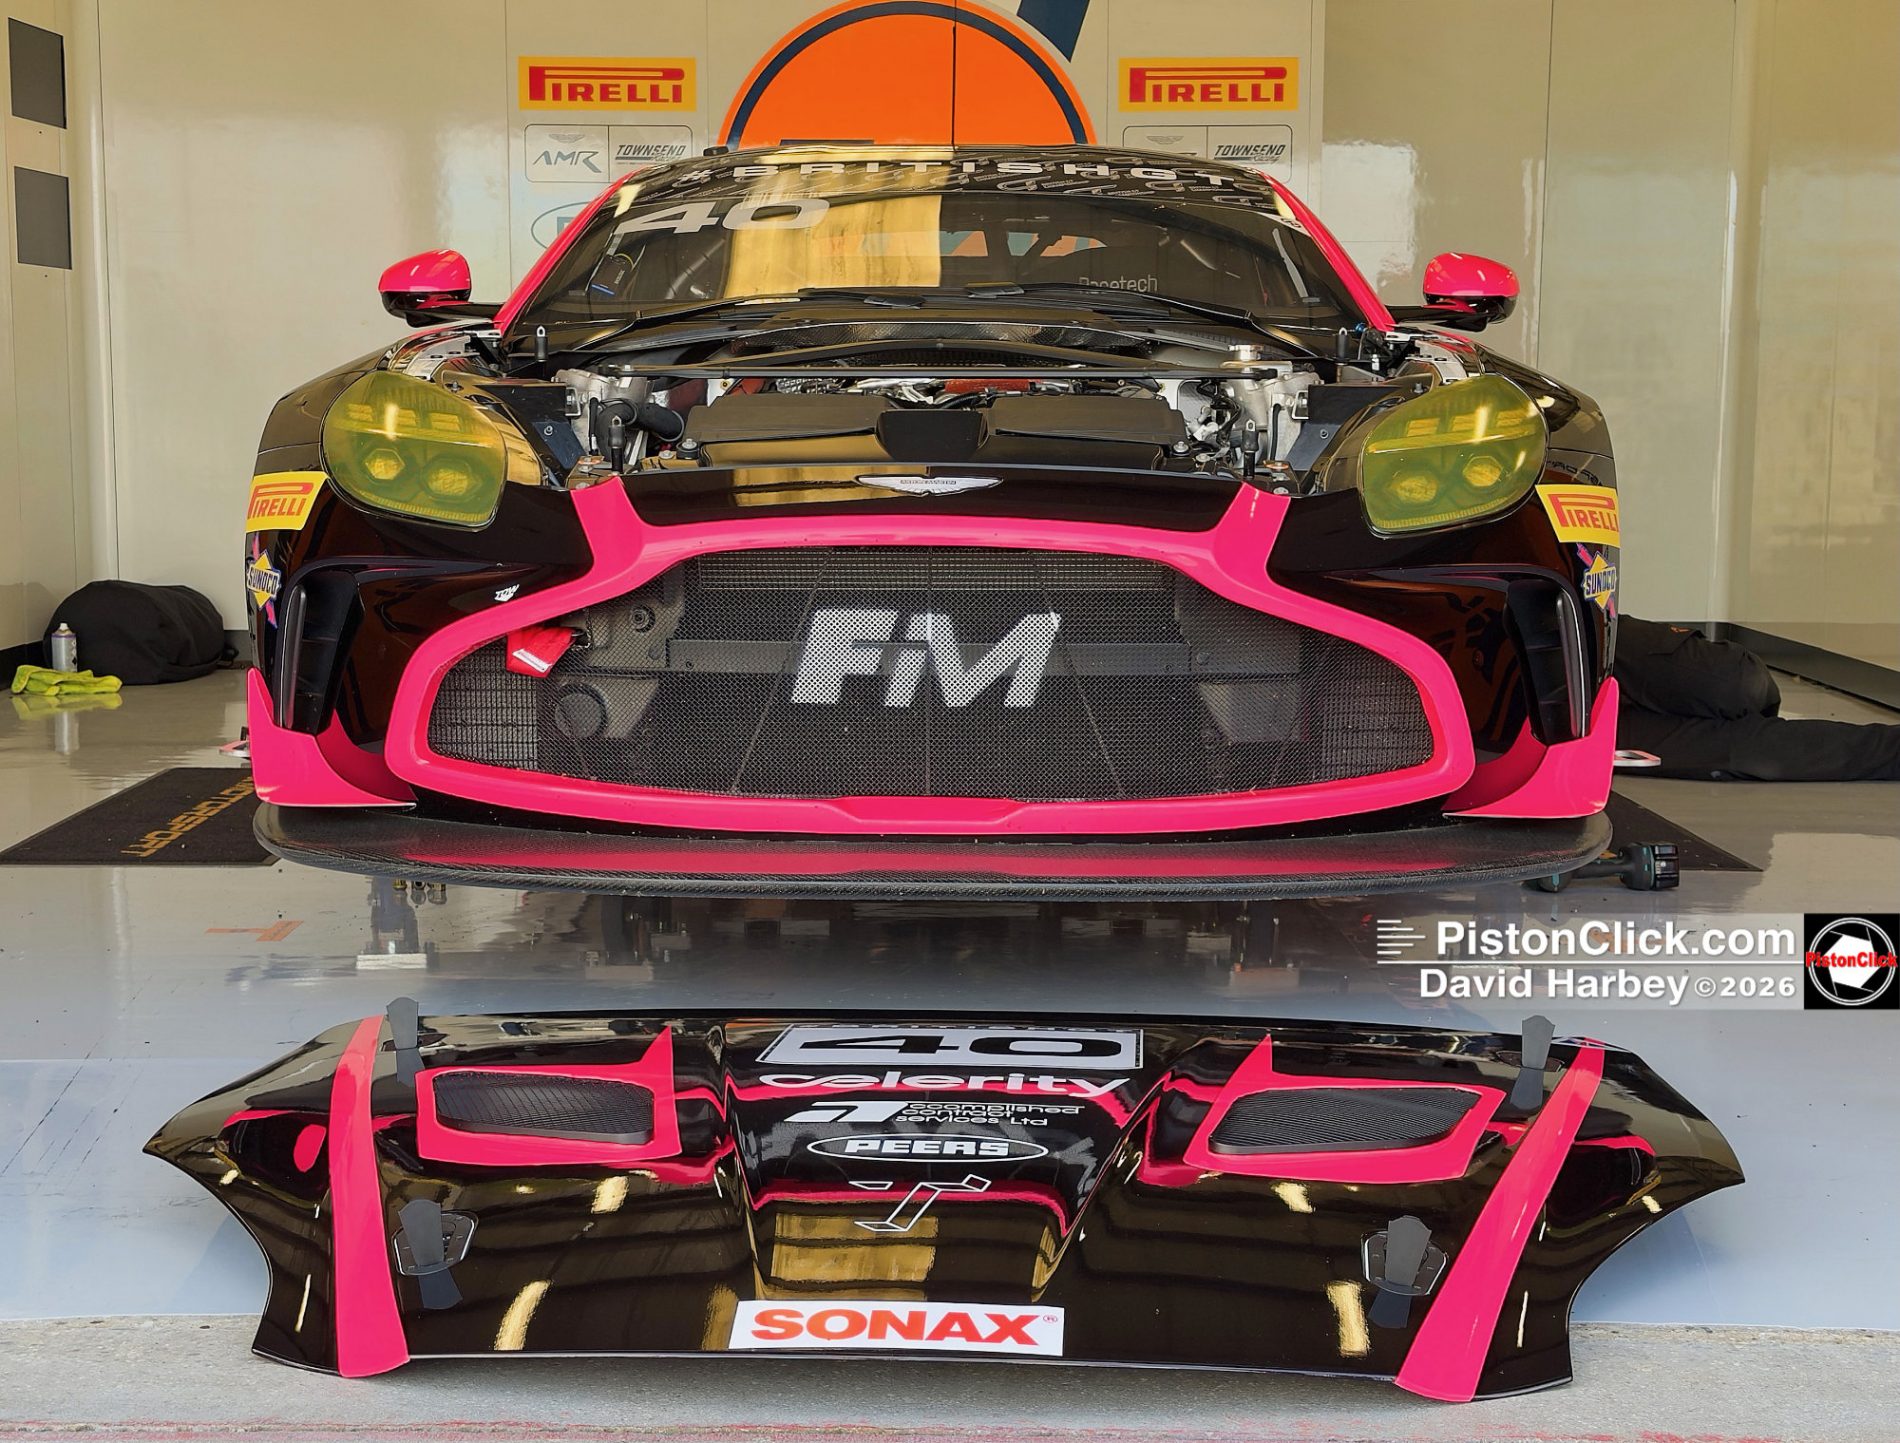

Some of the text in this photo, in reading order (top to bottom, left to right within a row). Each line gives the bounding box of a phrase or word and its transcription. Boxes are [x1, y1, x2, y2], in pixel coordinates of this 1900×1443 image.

[529, 66, 684, 103] PIRELLI
[1129, 67, 1287, 103] PIRELLI
[533, 150, 602, 173] AMR
[617, 145, 686, 156] TOWNSEND
[1215, 144, 1286, 156] TOWNSEND
[615, 199, 831, 234] 40
[247, 482, 314, 519] PIRELLI
[1548, 494, 1619, 532] PIRELLI
[249, 566, 278, 595] SUNOCO
[1586, 568, 1616, 595] SUNOCO
[800, 1035, 1122, 1057] 40
[759, 1071, 1130, 1098] celerity
[896, 1115, 1049, 1126] services Ltd
[901, 1108, 1013, 1118] contract
[845, 1139, 1009, 1156] PEERS
